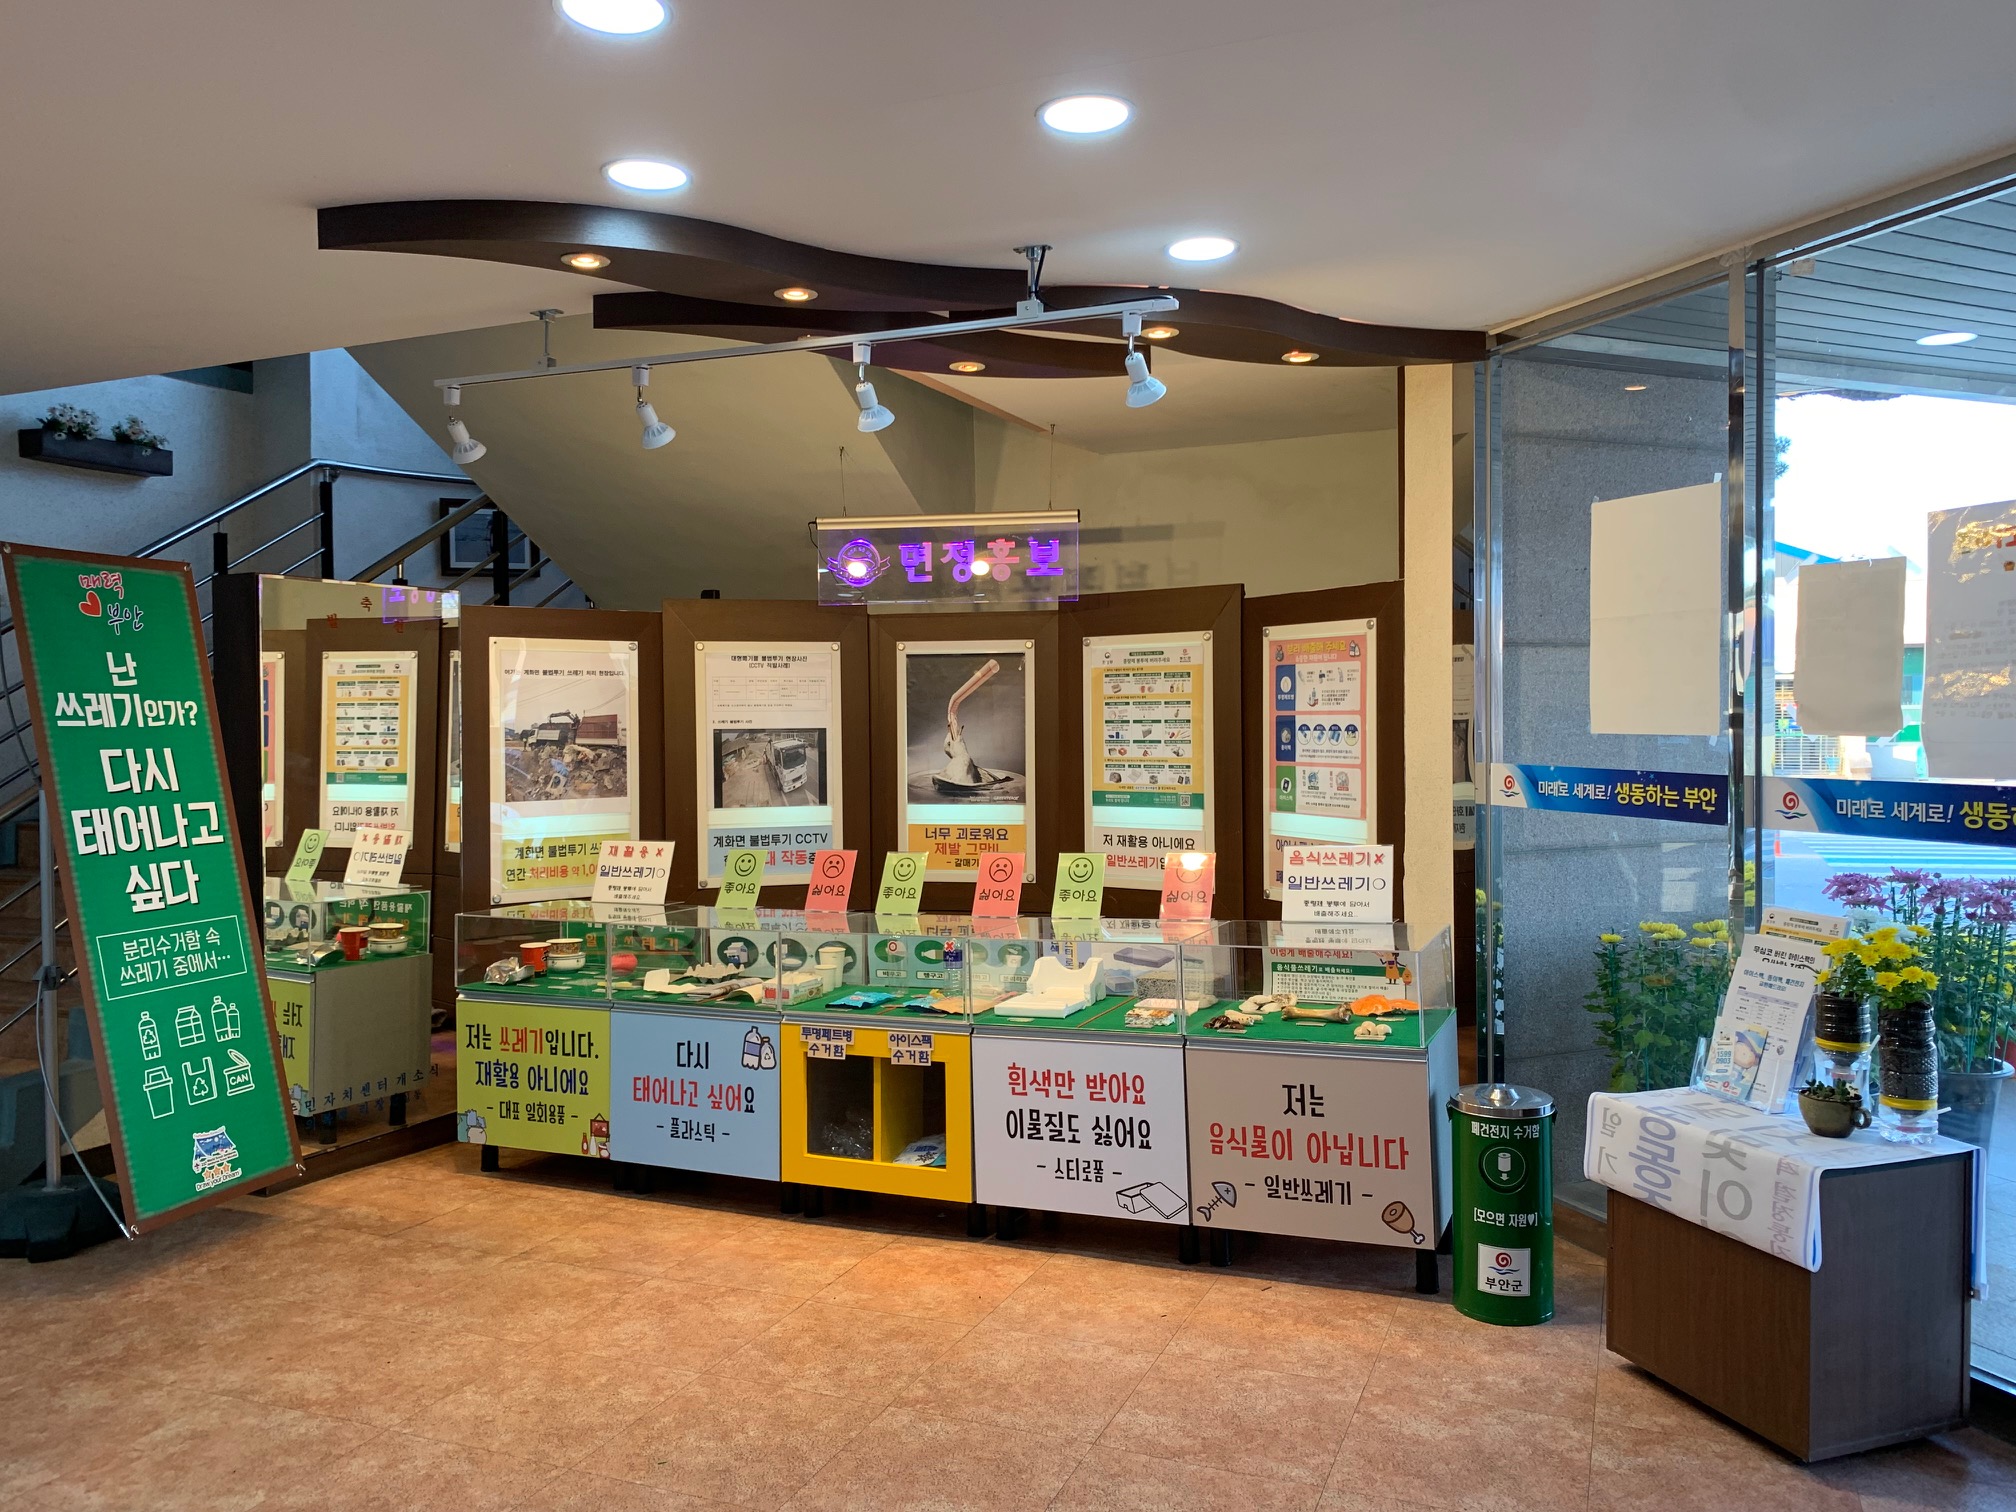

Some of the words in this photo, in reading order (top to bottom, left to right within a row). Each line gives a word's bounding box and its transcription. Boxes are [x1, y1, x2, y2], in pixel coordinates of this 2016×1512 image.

[898, 538, 1064, 583] 면정홍보
[79, 571, 124, 599] 매력
[107, 604, 144, 635] 부안
[106, 651, 138, 687] 난
[55, 692, 198, 728] 쓰레기인가?
[100, 748, 180, 794] 다시
[1538, 781, 1570, 797] 미래로
[1572, 783, 1612, 800] 세계로!
[1614, 782, 1680, 808] 생동하는
[1682, 787, 1718, 811] 부안
[1836, 798, 1886, 820] 미래로
[1890, 801, 1954, 823] 세계로!
[1959, 801, 2016, 831] 생동
[71, 802, 225, 855] 태어나고
[925, 828, 952, 841] 너무
[956, 828, 1009, 841] 괴로워요
[515, 846, 545, 859] 계화면
[547, 843, 587, 858] 불법투기
[590, 843, 602, 855] 쓰
[714, 835, 746, 848] 계화면
[749, 833, 792, 847] 불법투기
[795, 833, 828, 844] CCTV
[934, 842, 961, 855] 제발
[966, 841, 999, 855] 그만!!
[1103, 834, 1113, 847] 저
[1117, 834, 1148, 848] 재활용
[1152, 836, 1196, 850] 아니에요
[1289, 850, 1371, 866] 음식쓰레기
[506, 868, 527, 882] 연간
[529, 864, 569, 880] 처리비용
[571, 866, 580, 876] 약
[582, 864, 598, 877] 1,0
[600, 865, 656, 879] 일반쓰레기
[126, 859, 200, 912] 싶다
[724, 881, 756, 894] 좋아요
[811, 884, 846, 896] 싫어요
[882, 886, 917, 900] 좋아요
[978, 887, 1016, 901] 싫어요
[1288, 876, 1370, 891] 일반쓰레기
[1059, 889, 1098, 903] 좋아요
[1166, 890, 1208, 903] 싫어요
[1349, 900, 1370, 908] 담아서
[122, 929, 201, 962] 분리수거함
[205, 926, 221, 946] 속
[119, 961, 168, 987] 쓰레기
[465, 1023, 492, 1050] 저는
[499, 1026, 599, 1060] 쓰레기입니다.
[801, 1026, 852, 1043] 투명페트병
[889, 1034, 932, 1048] 아이스팩
[676, 1040, 710, 1070] 다시
[808, 1043, 844, 1058] 수거함
[893, 1049, 930, 1063] 수거함
[229, 1073, 249, 1086] CAN
[475, 1059, 520, 1089] 재활용
[527, 1064, 589, 1096] 아니에요
[1007, 1062, 1076, 1100] 흰색만
[1085, 1072, 1146, 1105] 받아요
[632, 1075, 699, 1107] 태어나고
[707, 1084, 755, 1114] 싶어요
[1281, 1083, 1326, 1118] 저는
[499, 1100, 520, 1121] 대표
[525, 1101, 566, 1125] 일회용품
[670, 1117, 716, 1143] 플라스틱
[1006, 1108, 1082, 1144] 이물질도
[1091, 1114, 1152, 1150] 싫어요
[1471, 1121, 1510, 1140] 폐건전지
[1513, 1123, 1540, 1139] 수거함
[1208, 1122, 1293, 1162] 음식물이
[1306, 1130, 1410, 1171] 아닙니다
[1054, 1157, 1105, 1184] 스티로폼
[196, 1181, 210, 1190] Draw
[1264, 1175, 1352, 1206] 일반쓰레기
[1485, 1276, 1524, 1292] 부안군
